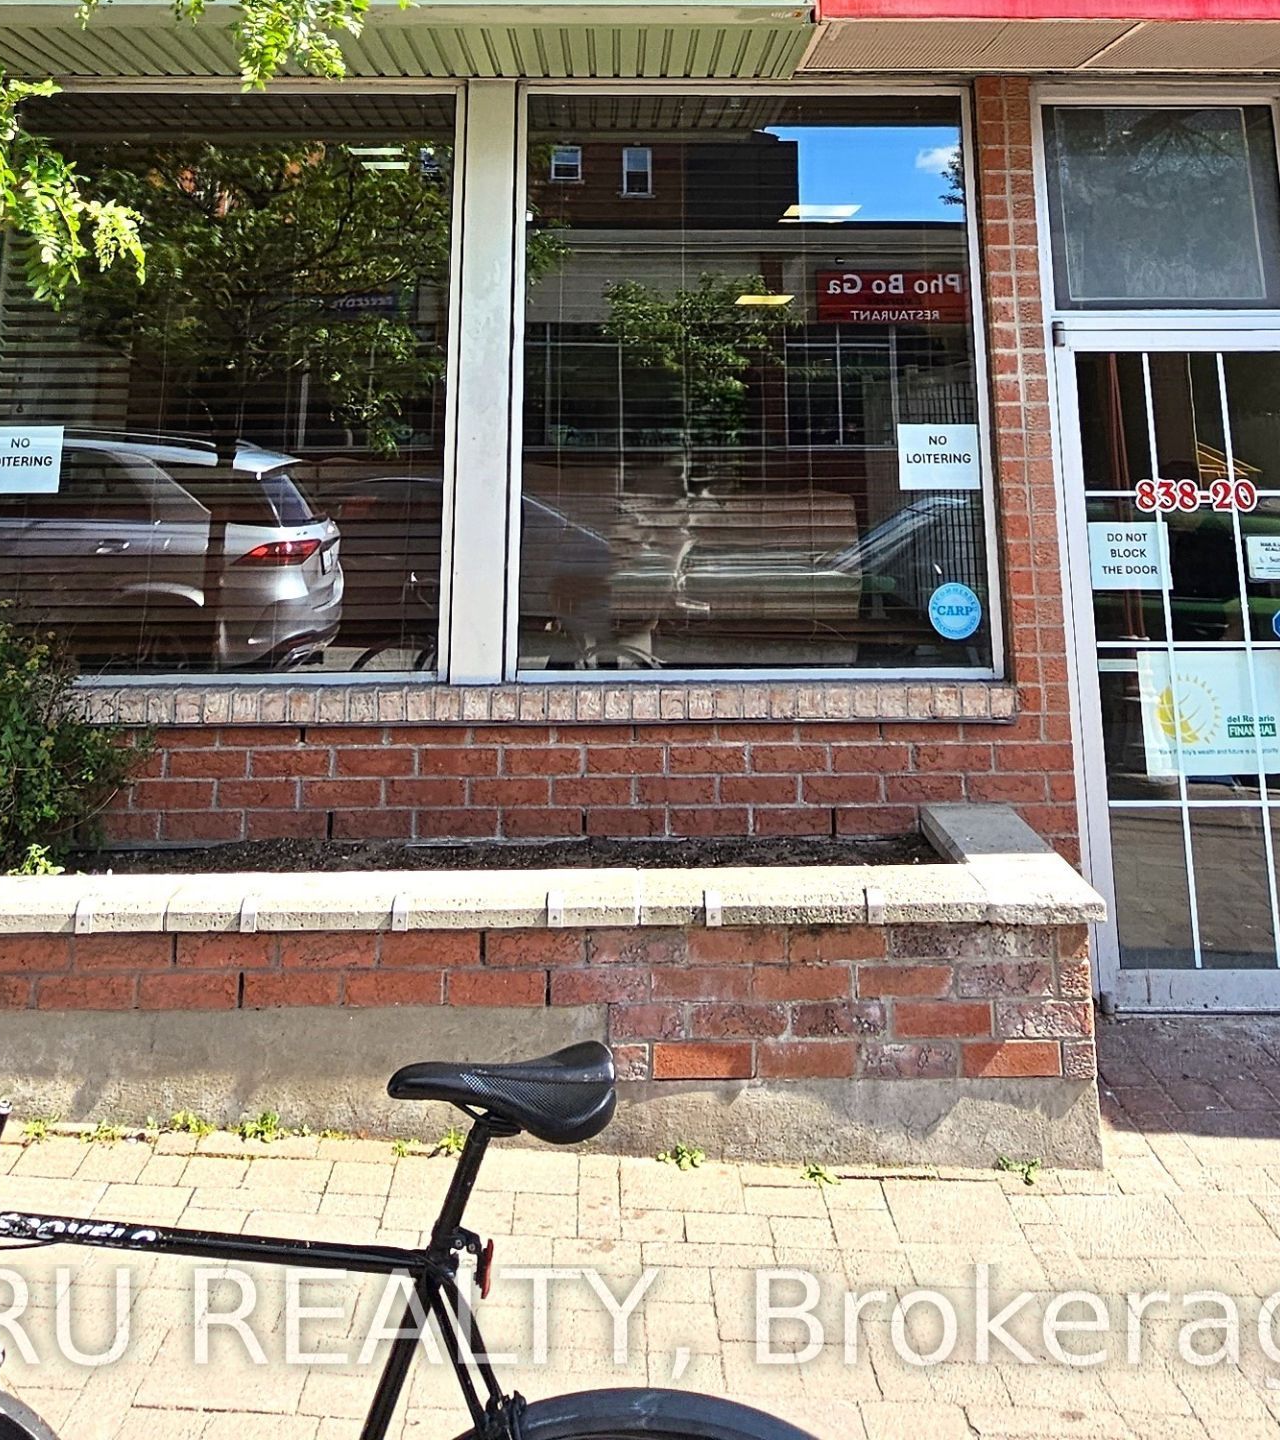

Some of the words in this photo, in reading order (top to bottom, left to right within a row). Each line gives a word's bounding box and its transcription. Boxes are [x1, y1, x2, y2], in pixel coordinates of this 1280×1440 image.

[10, 438, 31, 449] NO
[928, 435, 947, 446] NO
[906, 453, 972, 464] LOITERING
[1136, 479, 1256, 512] 838-20
[1107, 533, 1123, 542] DO
[1126, 533, 1148, 542] NOT
[1110, 548, 1147, 558] BLOCK
[1102, 565, 1123, 575] THE
[1125, 565, 1159, 575] DOOR
[937, 605, 973, 616] CARP
[1242, 714, 1275, 723] Roario
[1229, 724, 1276, 736] FINANIAL
